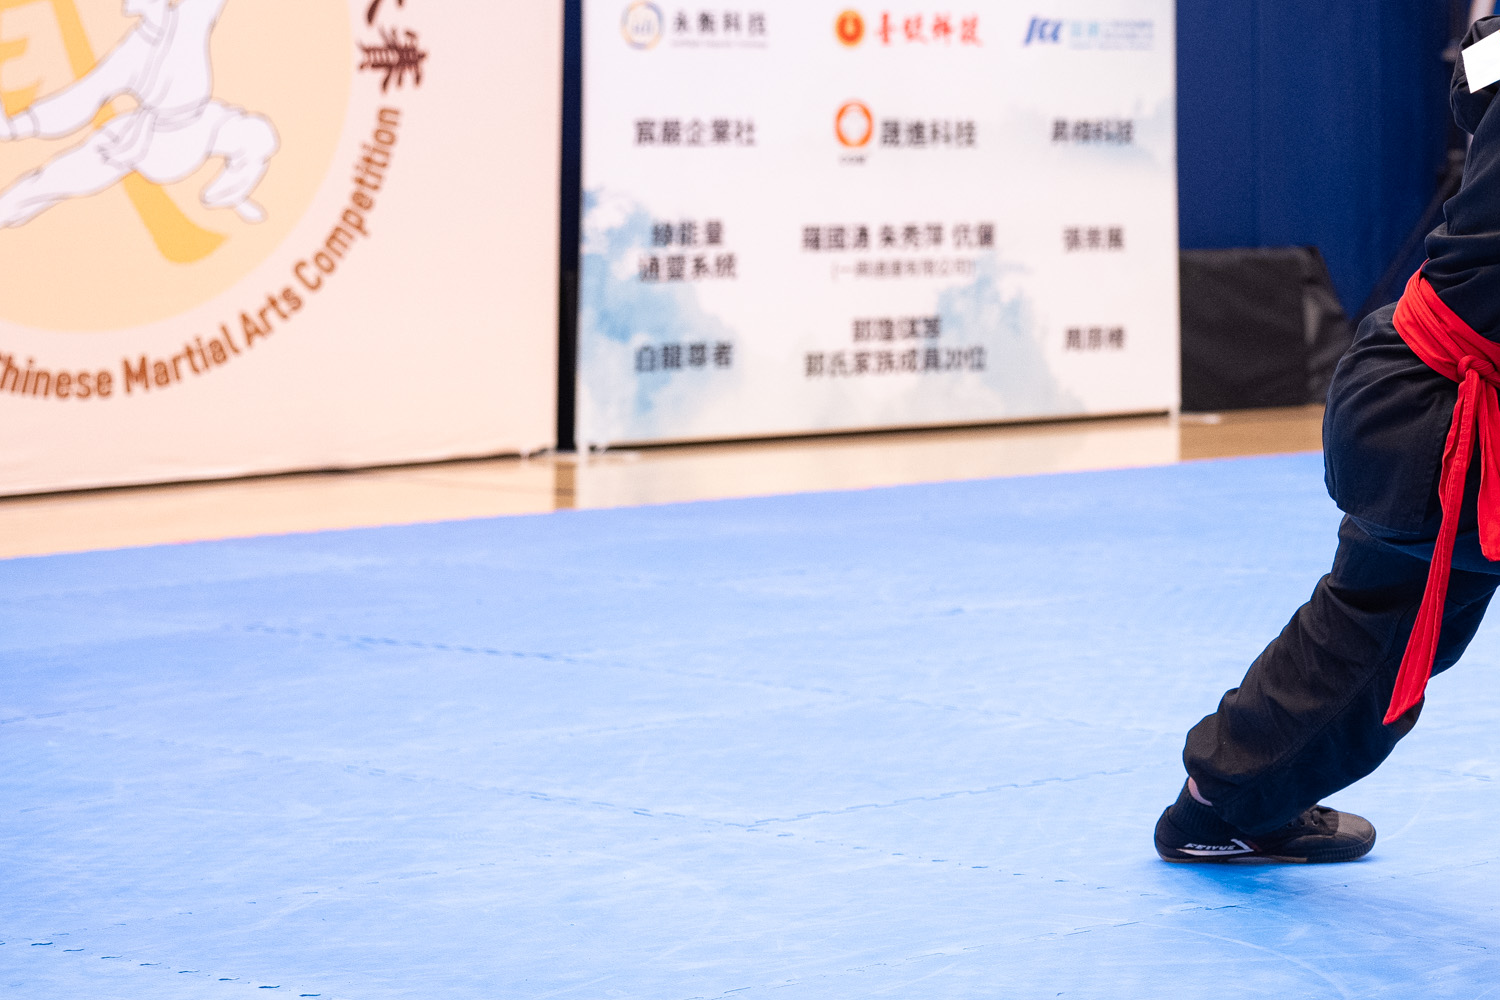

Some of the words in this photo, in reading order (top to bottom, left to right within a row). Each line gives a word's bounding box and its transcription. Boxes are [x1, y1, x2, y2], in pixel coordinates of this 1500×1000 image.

[0, 353, 114, 400] hinese
[121, 322, 242, 396] Martial
[238, 286, 304, 348] Arts
[293, 105, 403, 293] Competition
